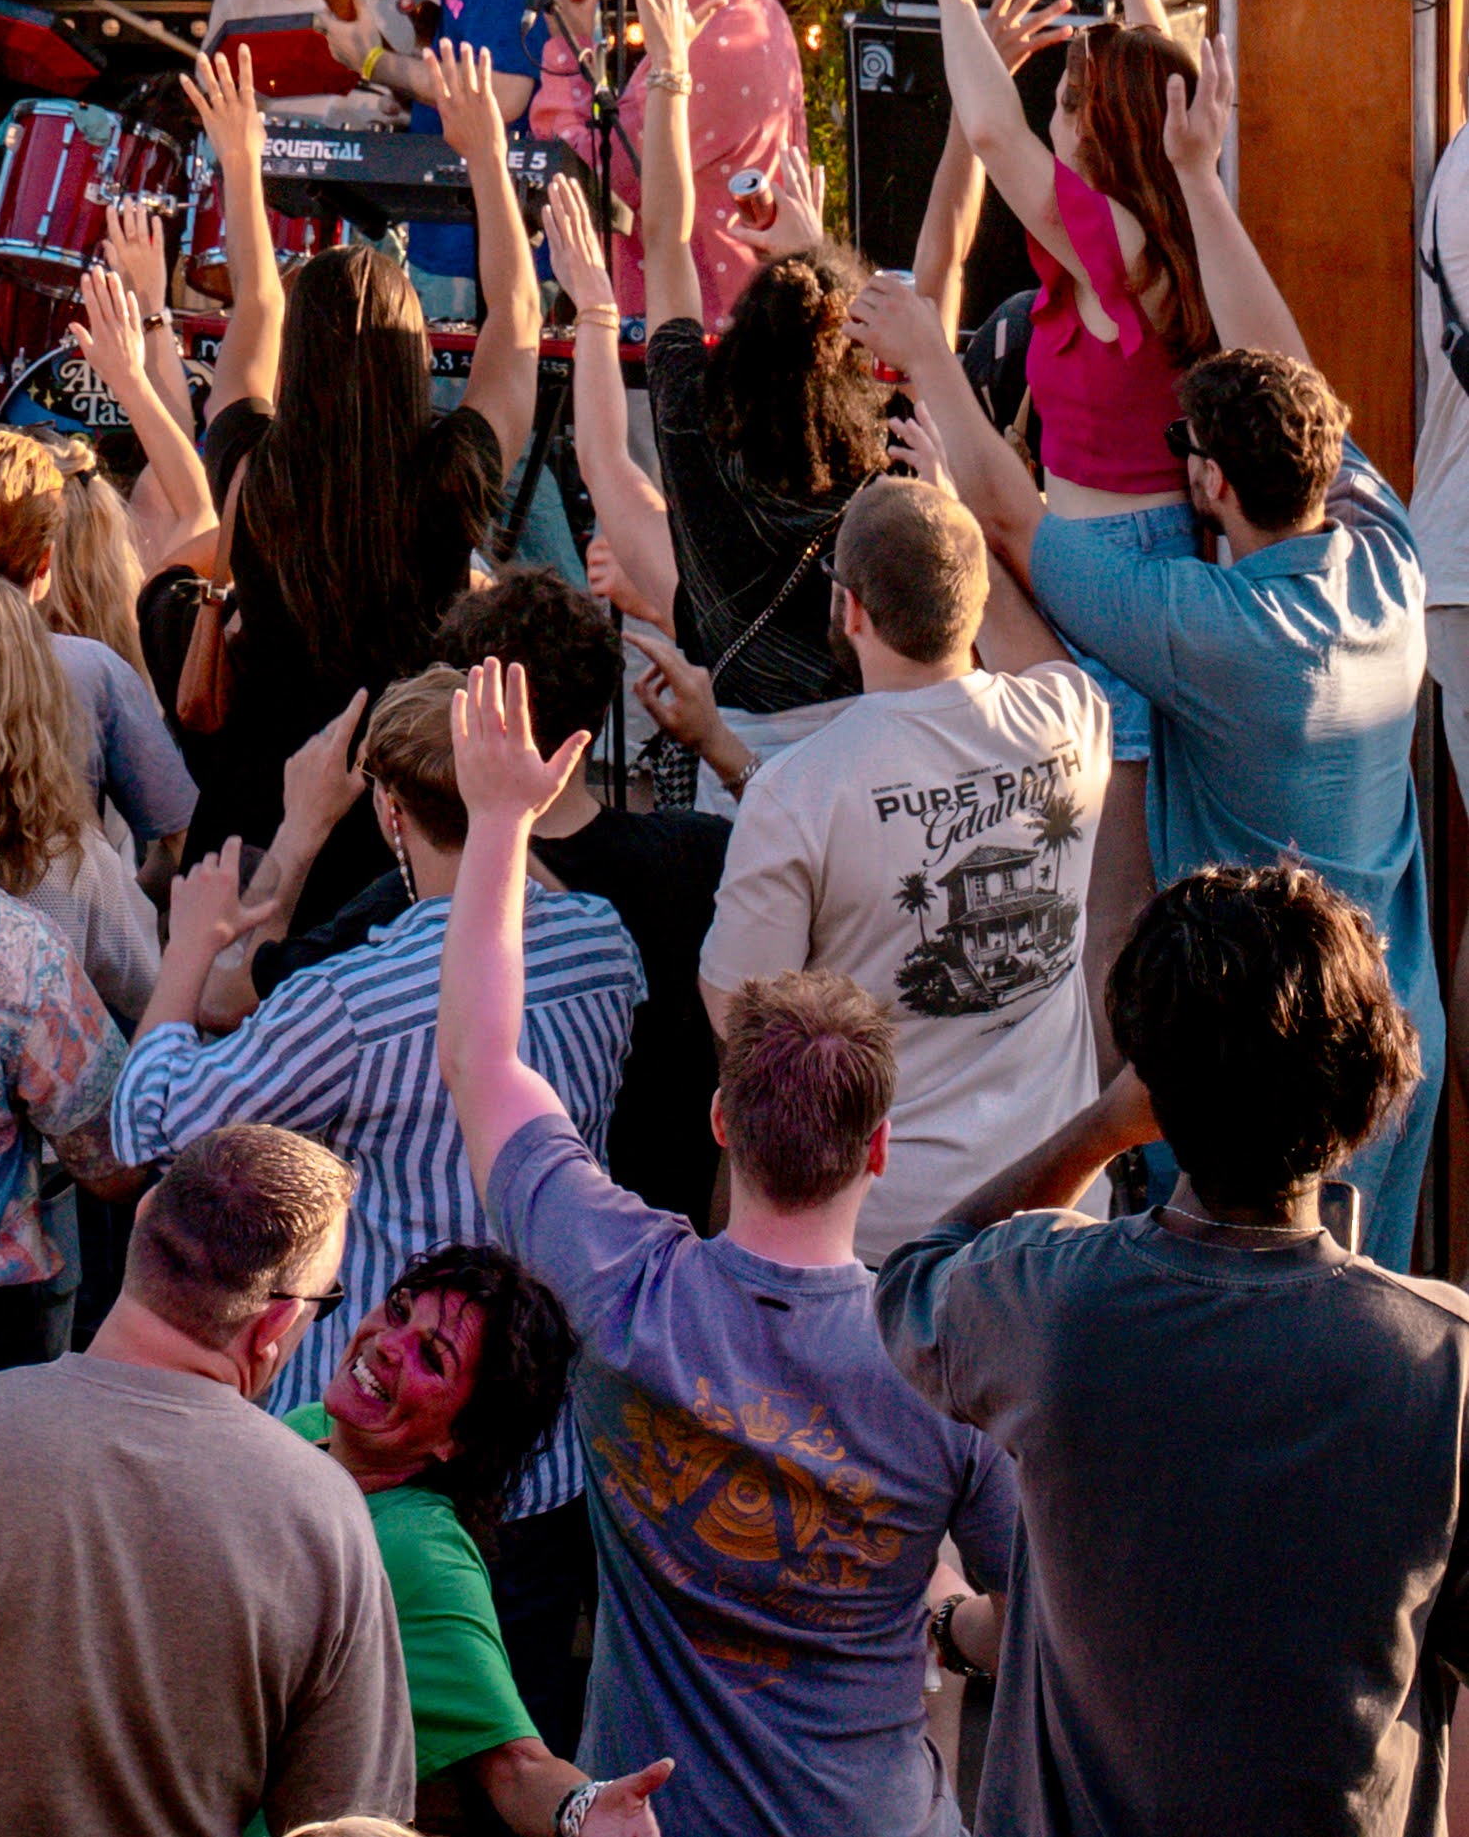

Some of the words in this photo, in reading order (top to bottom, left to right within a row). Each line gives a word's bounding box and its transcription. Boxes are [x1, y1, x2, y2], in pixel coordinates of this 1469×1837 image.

[261, 138, 364, 161] EQUENTIAL
[875, 781, 979, 822] PURE
[993, 750, 1082, 798] PATH
[920, 772, 1059, 867] Getaway
